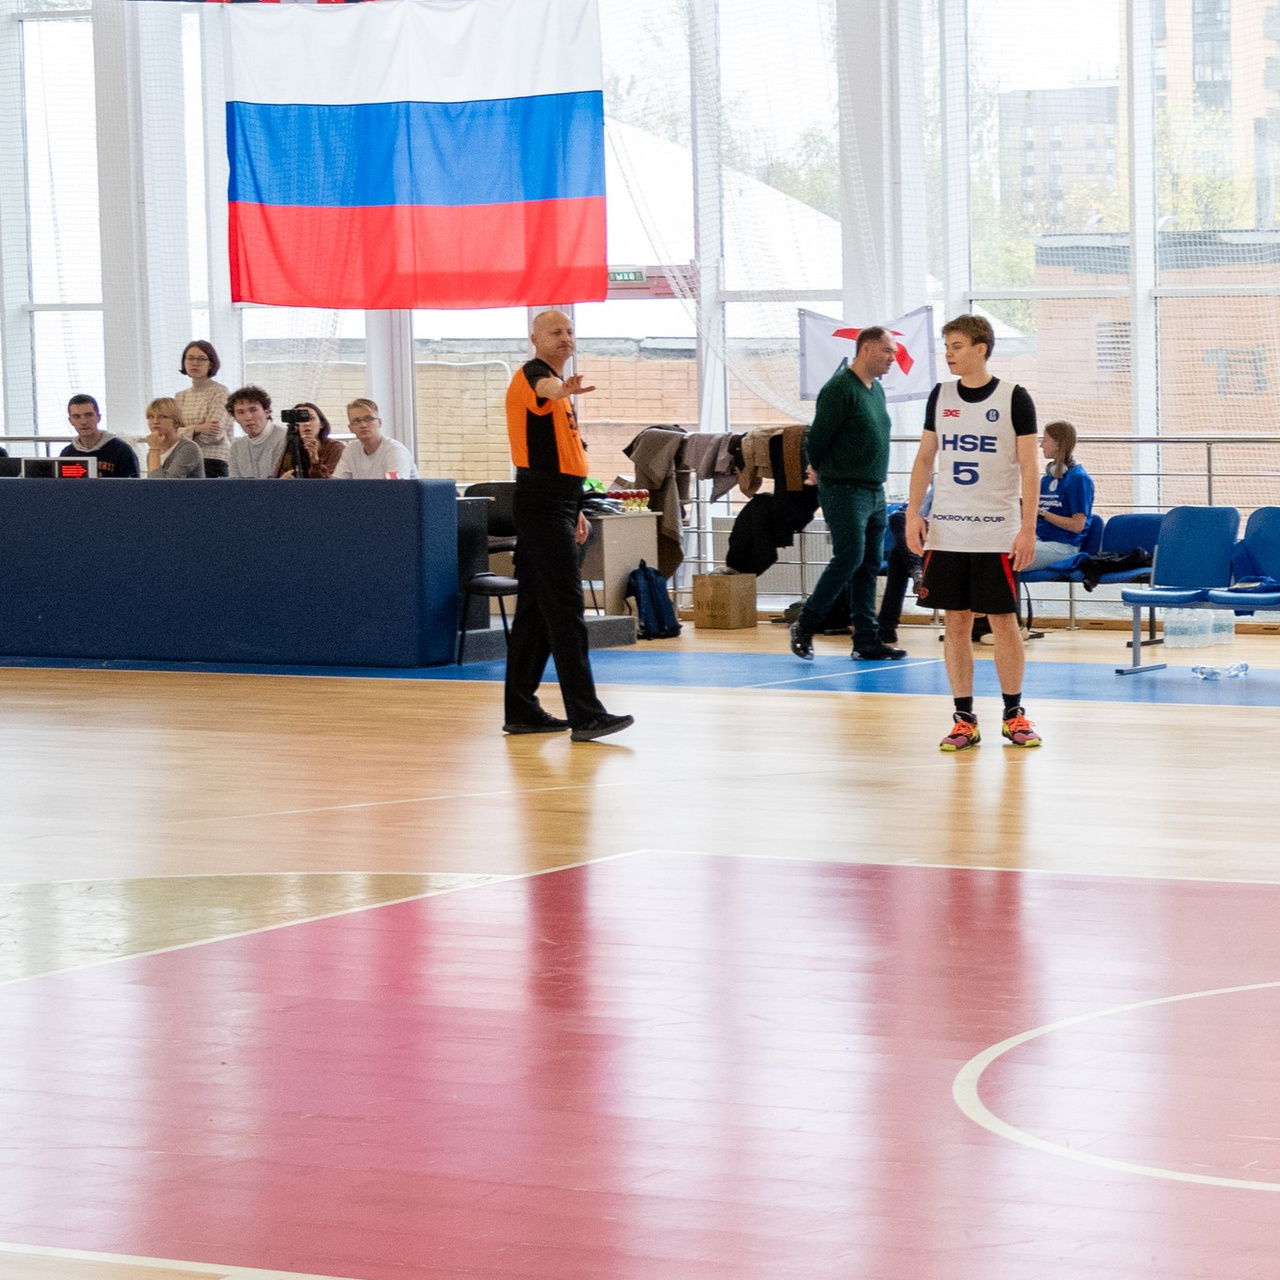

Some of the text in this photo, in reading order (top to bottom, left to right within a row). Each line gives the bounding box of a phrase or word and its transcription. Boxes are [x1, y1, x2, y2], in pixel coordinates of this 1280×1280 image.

[942, 434, 998, 453] HSE
[953, 461, 979, 485] 5
[933, 513, 981, 523] POKROVKA
